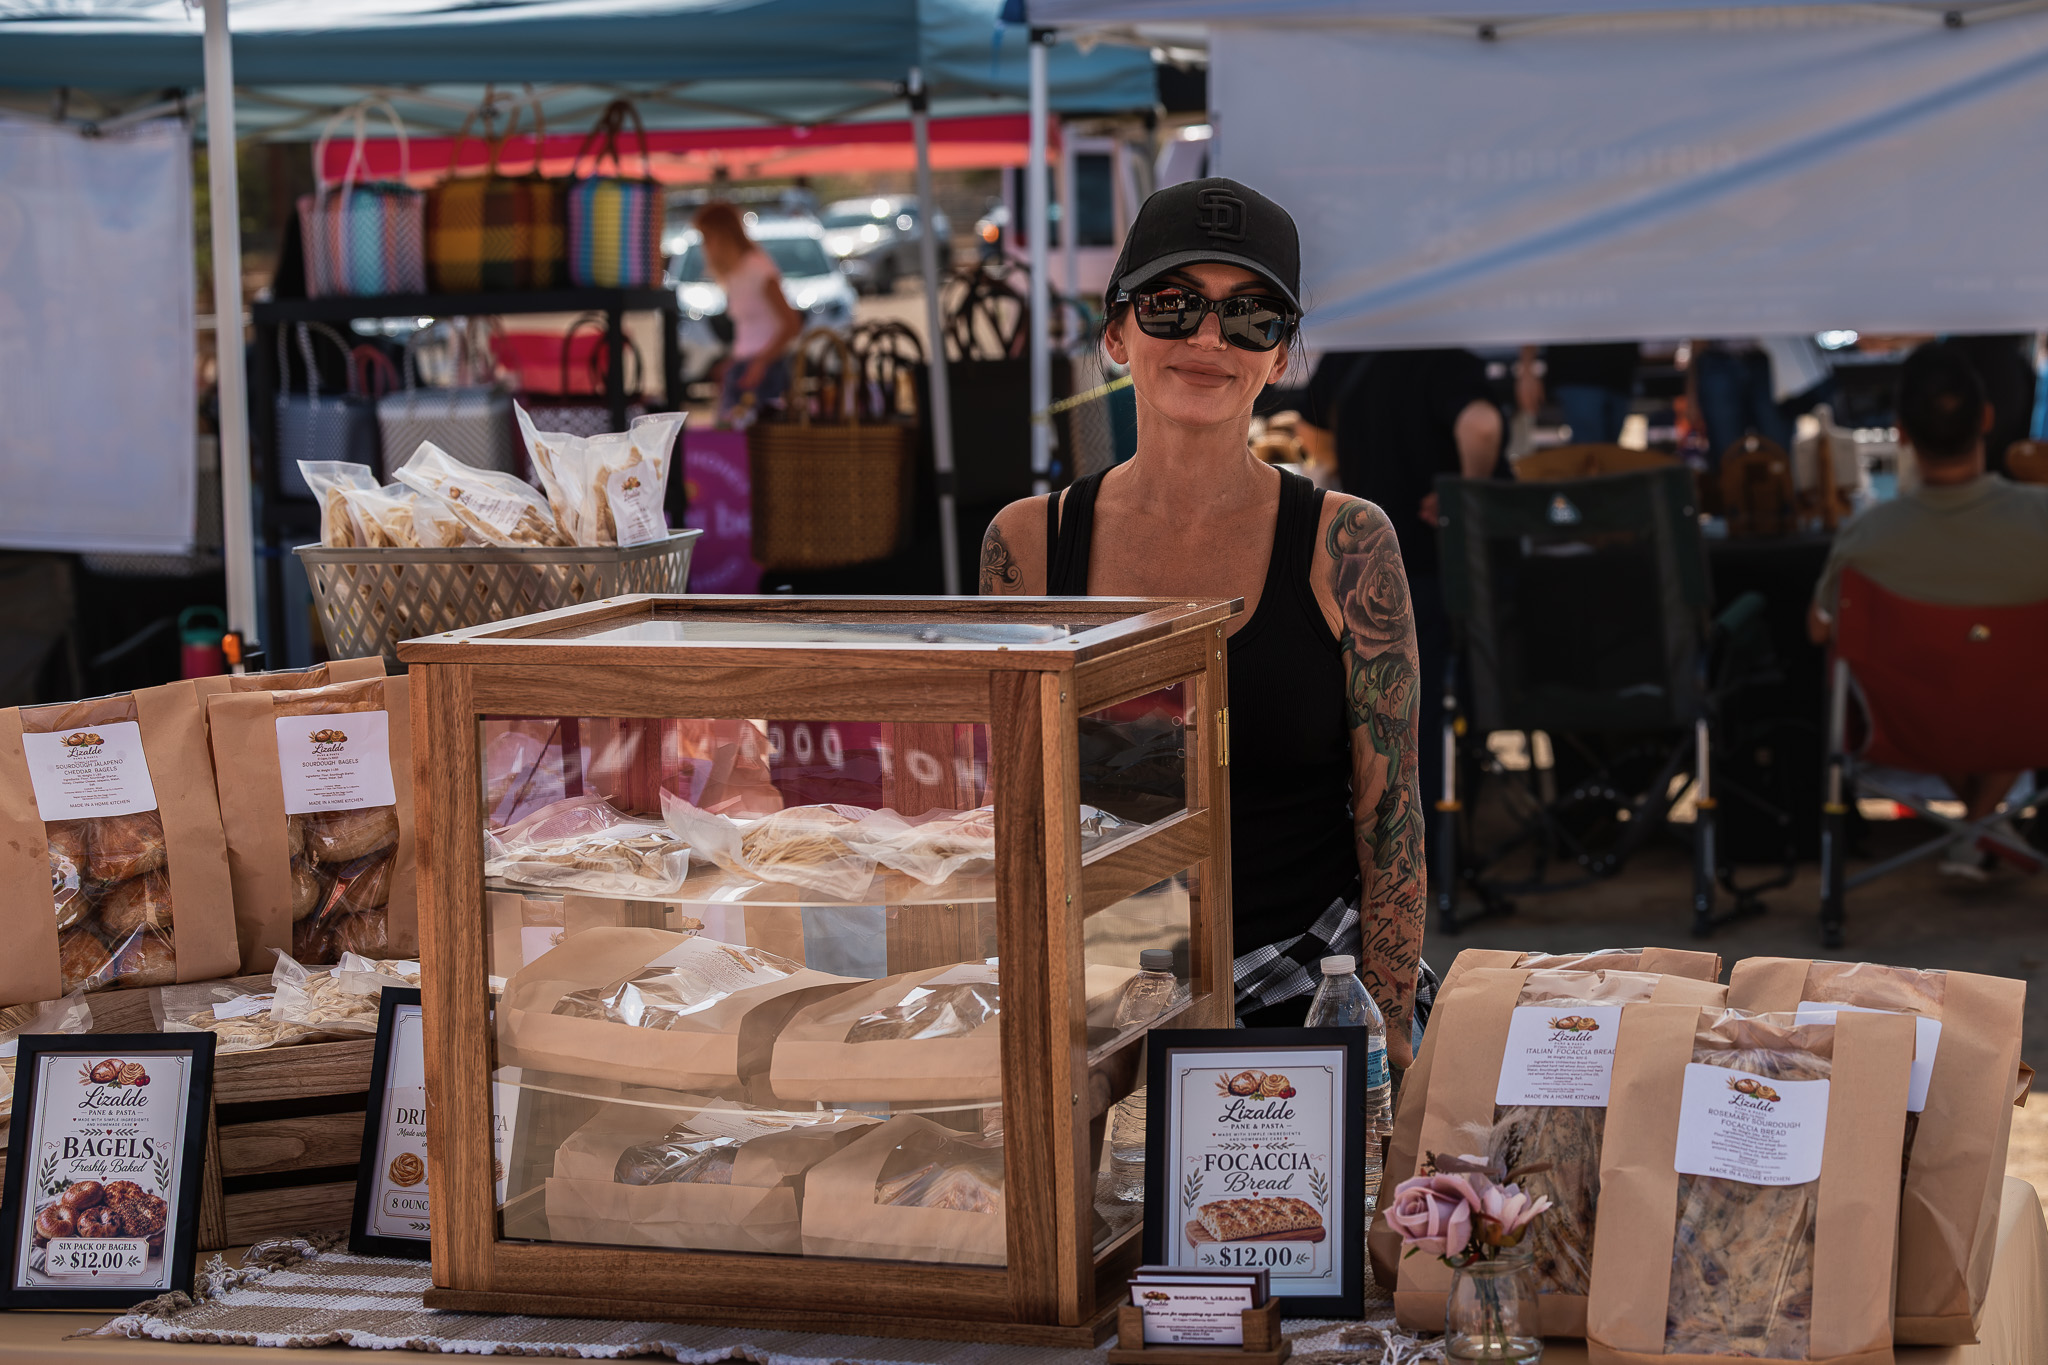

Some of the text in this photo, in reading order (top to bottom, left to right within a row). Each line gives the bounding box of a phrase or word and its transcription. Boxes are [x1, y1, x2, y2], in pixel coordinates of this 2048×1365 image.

[1196, 188, 1248, 242] SD
[67, 746, 102, 758] Lizalde
[312, 743, 345, 755] Lizalde
[56, 762, 93, 770] SOURDOUGH
[64, 768, 92, 776] CHEDDAR
[94, 766, 118, 774] BAGELS
[302, 760, 336, 768] SOURDOUGH
[1548, 1030, 1593, 1042] Lizalde
[78, 1086, 149, 1109] Lizalde
[1728, 1094, 1775, 1114] Lizalde
[396, 1108, 427, 1126] DRI
[1218, 1098, 1296, 1122] Lizalde
[1708, 1108, 1750, 1122] ROSEMARY
[1752, 1118, 1801, 1128] SOURDOUGH
[397, 1128, 416, 1137] Made
[1721, 1119, 1786, 1136] FOCACCIA BREAD
[61, 1136, 155, 1160] BAGELS
[69, 1159, 148, 1175] Freshly Baked
[1204, 1152, 1312, 1172] FOCACCIA
[1224, 1171, 1295, 1192] Bread
[1709, 1166, 1727, 1174] MADE
[1743, 1172, 1762, 1181] HOME
[1763, 1174, 1790, 1182] KITCHEN
[392, 1198, 430, 1211] 8 OUNC
[58, 1242, 72, 1250] SIX
[108, 1243, 138, 1251] BAGELS
[70, 1251, 124, 1270] $12.00
[1219, 1246, 1292, 1267] $12.00
